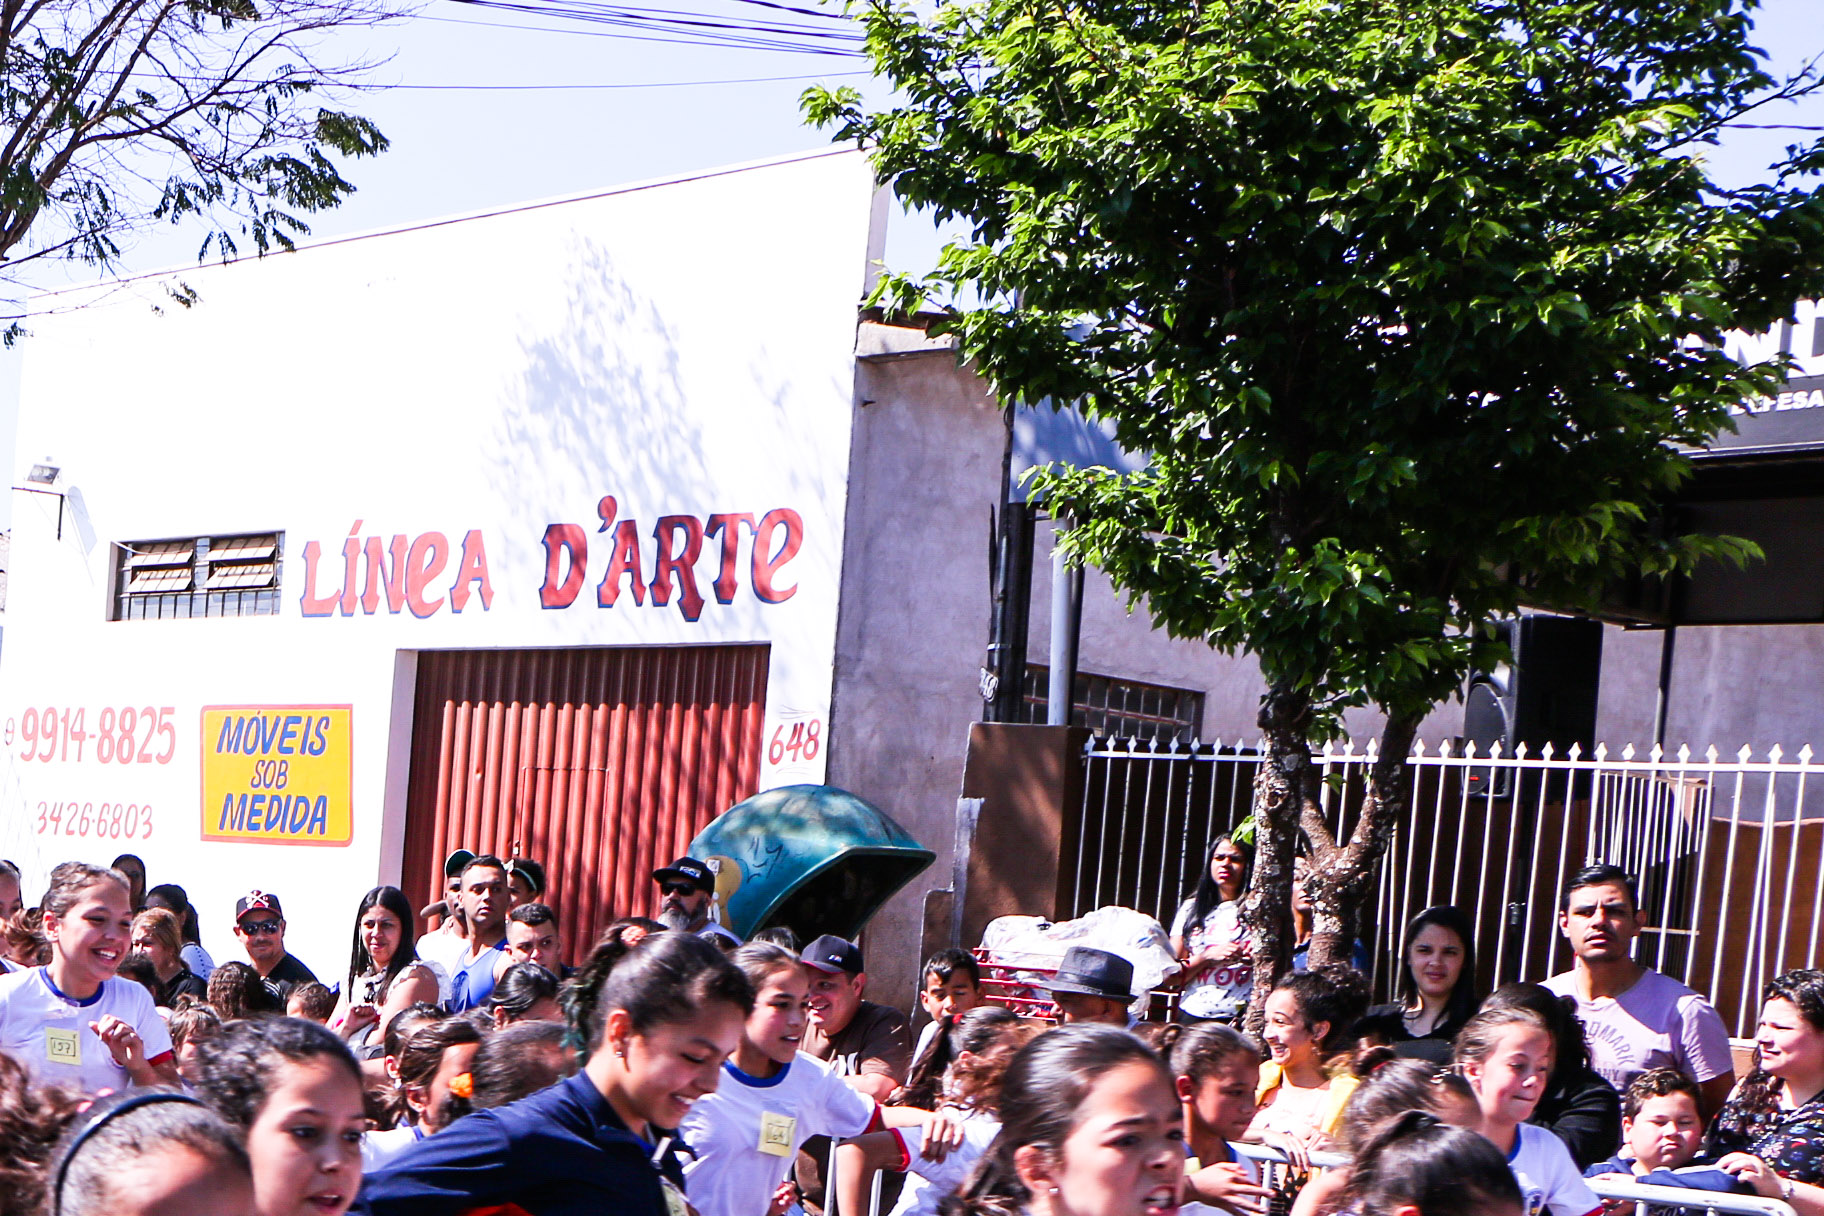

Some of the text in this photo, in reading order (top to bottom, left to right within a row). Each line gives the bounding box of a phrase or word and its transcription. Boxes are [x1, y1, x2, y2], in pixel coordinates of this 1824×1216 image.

[20, 706, 176, 765] 9914-8825
[216, 711, 331, 756] MÓVEIS
[768, 718, 822, 766] 648
[250, 760, 289, 790] SOB
[218, 793, 328, 836] MEDIDA
